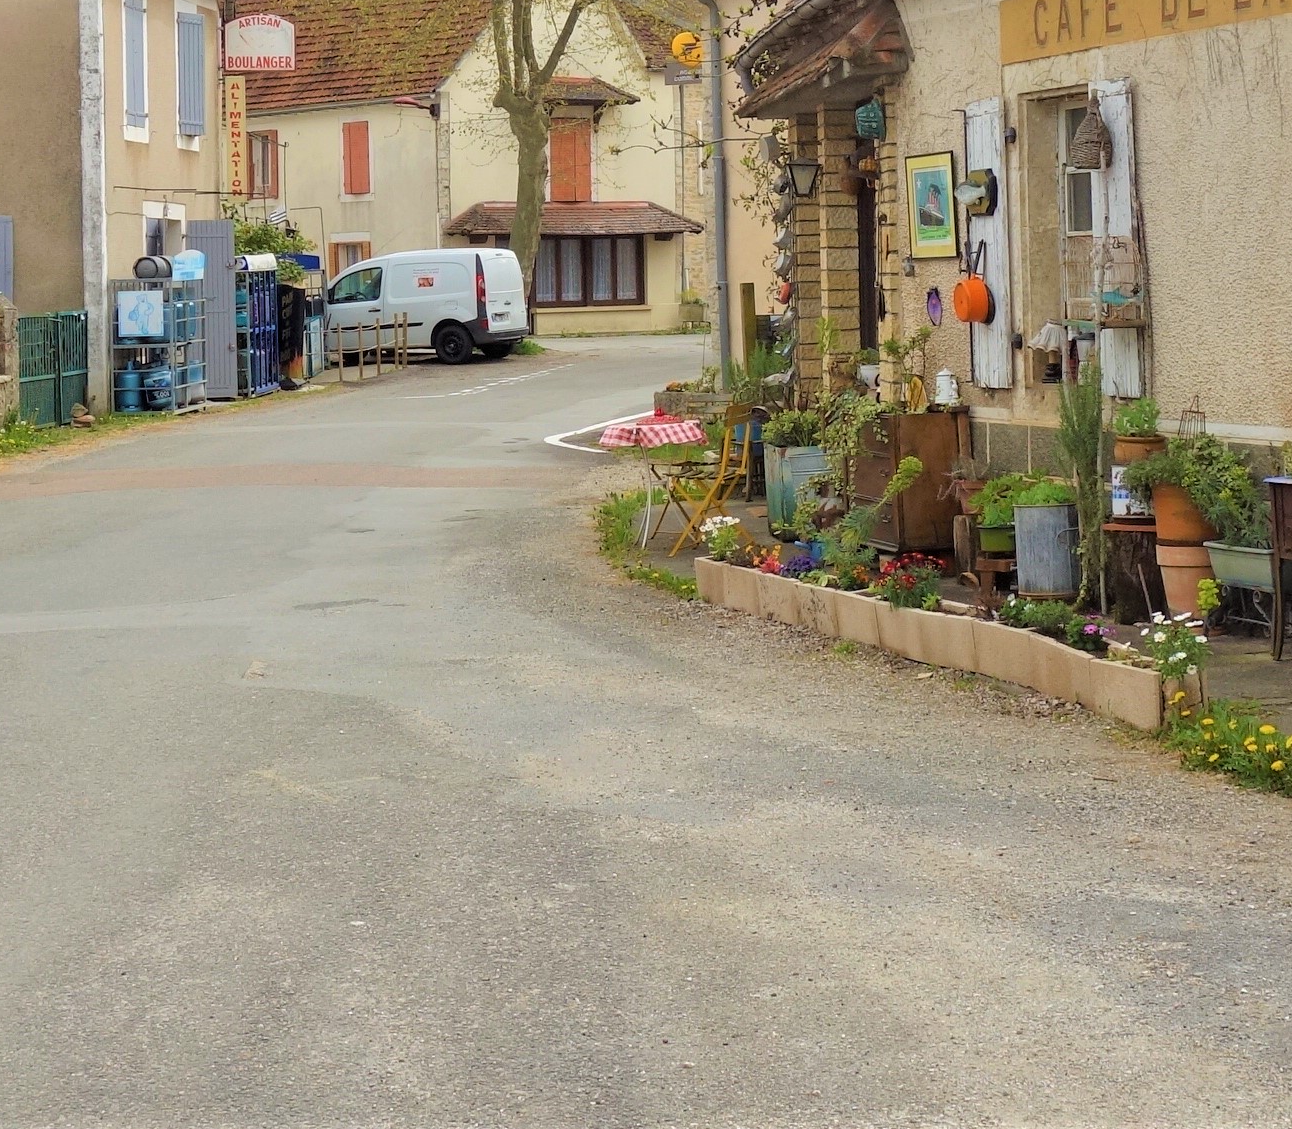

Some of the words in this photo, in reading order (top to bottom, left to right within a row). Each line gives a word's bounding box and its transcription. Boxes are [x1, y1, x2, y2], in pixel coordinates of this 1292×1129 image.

[238, 16, 281, 29] ARTISAN
[227, 56, 293, 69] BOULANGER
[229, 82, 243, 197] ALIMENTATION
